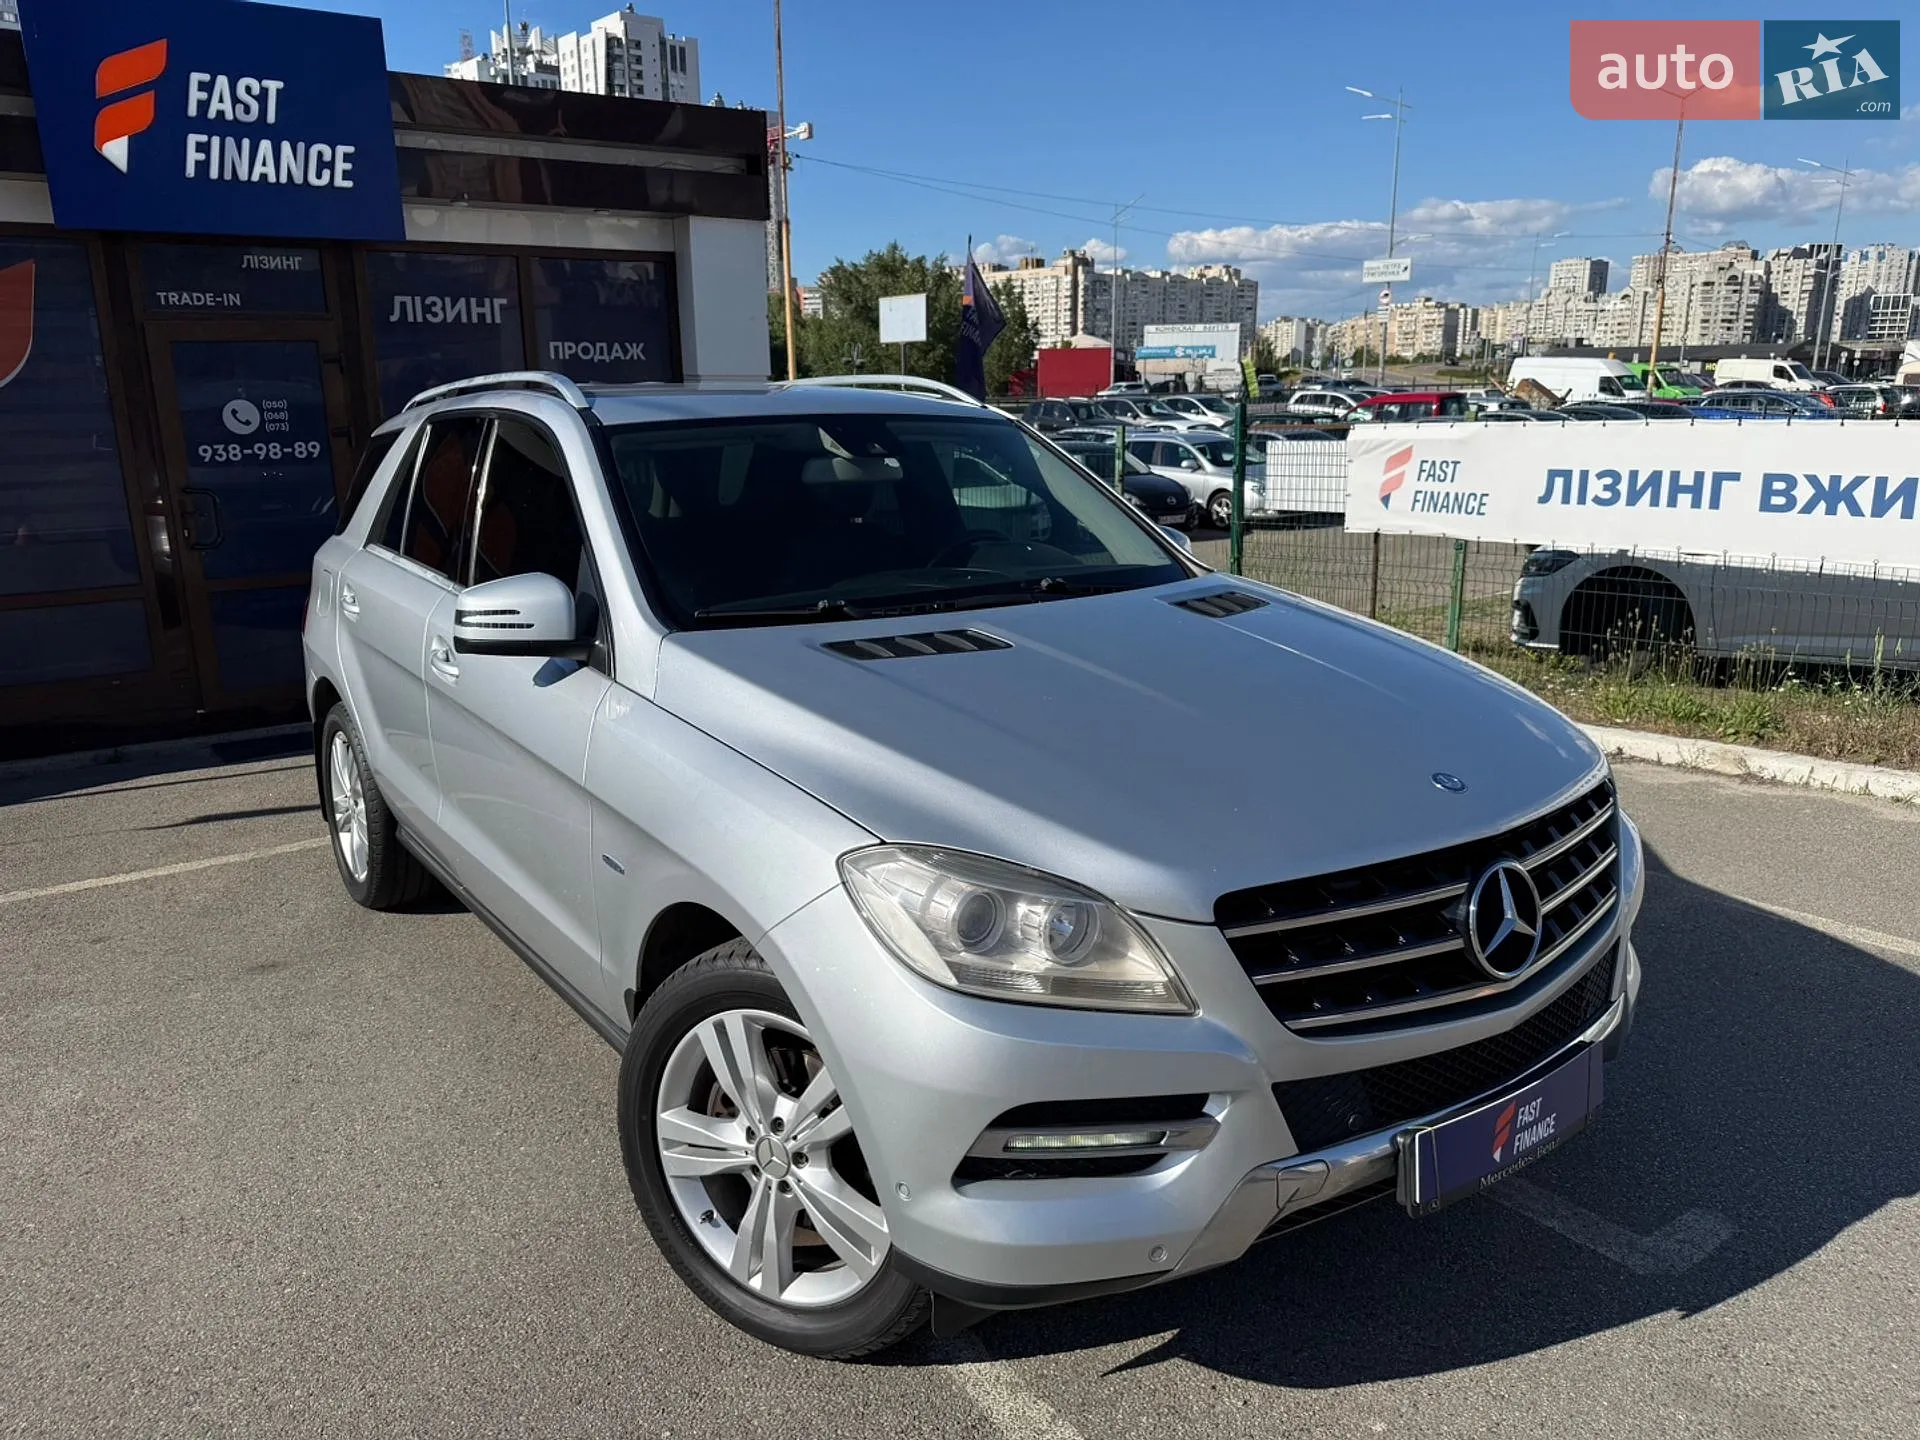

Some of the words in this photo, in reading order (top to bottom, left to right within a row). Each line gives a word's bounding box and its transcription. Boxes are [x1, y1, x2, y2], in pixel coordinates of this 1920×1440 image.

[186, 72, 284, 124] FAST
[185, 133, 356, 188] FINANCE
[241, 255, 302, 271] ЛІЗИНГ
[157, 291, 241, 307] TRADE-IN
[389, 295, 507, 324] ЛІЗИНГ
[549, 341, 646, 363] ПРОДАЖ
[262, 399, 287, 410] (050)
[265, 421, 289, 432] (073)
[198, 441, 321, 463] 938-98-89
[1416, 460, 1461, 484] FAST
[1410, 490, 1489, 516] FINANCE
[1537, 468, 1741, 511] ЛІЗИНГ
[1758, 472, 1920, 520] ВЖИ
[1516, 1097, 1542, 1129] FAST
[1513, 1112, 1556, 1156] FINANCE
